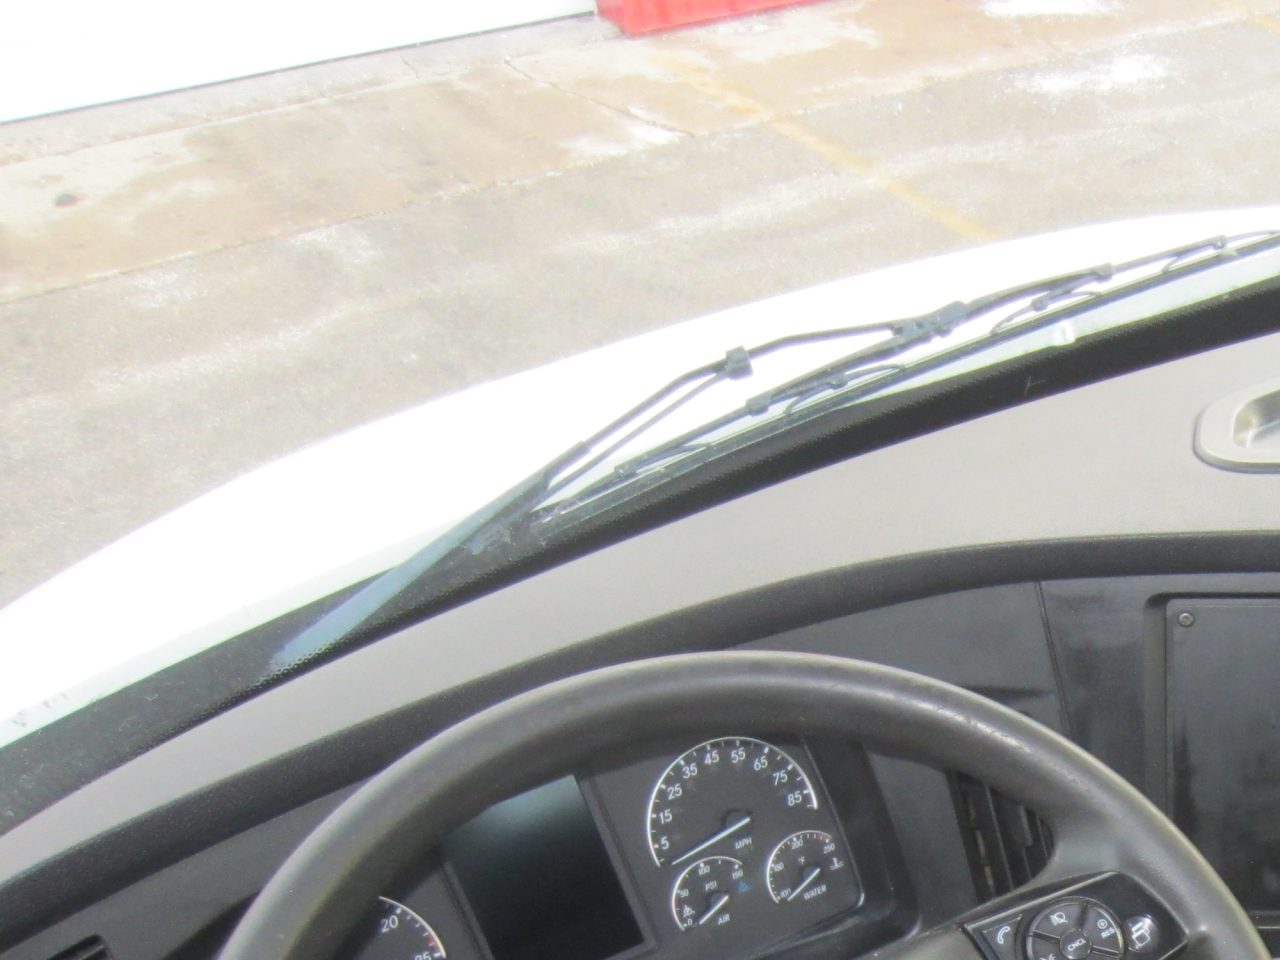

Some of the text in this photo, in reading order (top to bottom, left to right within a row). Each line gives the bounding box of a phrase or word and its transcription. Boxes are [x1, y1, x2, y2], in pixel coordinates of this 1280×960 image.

[704, 751, 719, 765] 45
[731, 748, 745, 763] 55
[754, 756, 768, 771] 65
[682, 763, 697, 779] 35
[773, 770, 788, 786] 75
[667, 784, 682, 800] 25
[787, 791, 802, 806] 85
[658, 809, 672, 824] 15
[661, 836, 669, 850] 5
[735, 838, 752, 850] MPH
[791, 840, 803, 850] 200
[823, 842, 835, 854] 250
[698, 865, 710, 876] 100
[774, 862, 784, 872] 150
[732, 869, 743, 880] 150
[705, 880, 717, 891] PSI
[803, 884, 826, 900] WATER
[680, 888, 689, 898] 50
[381, 915, 398, 933] 20
[718, 913, 730, 925] AIR
[1101, 927, 1115, 938] RES
